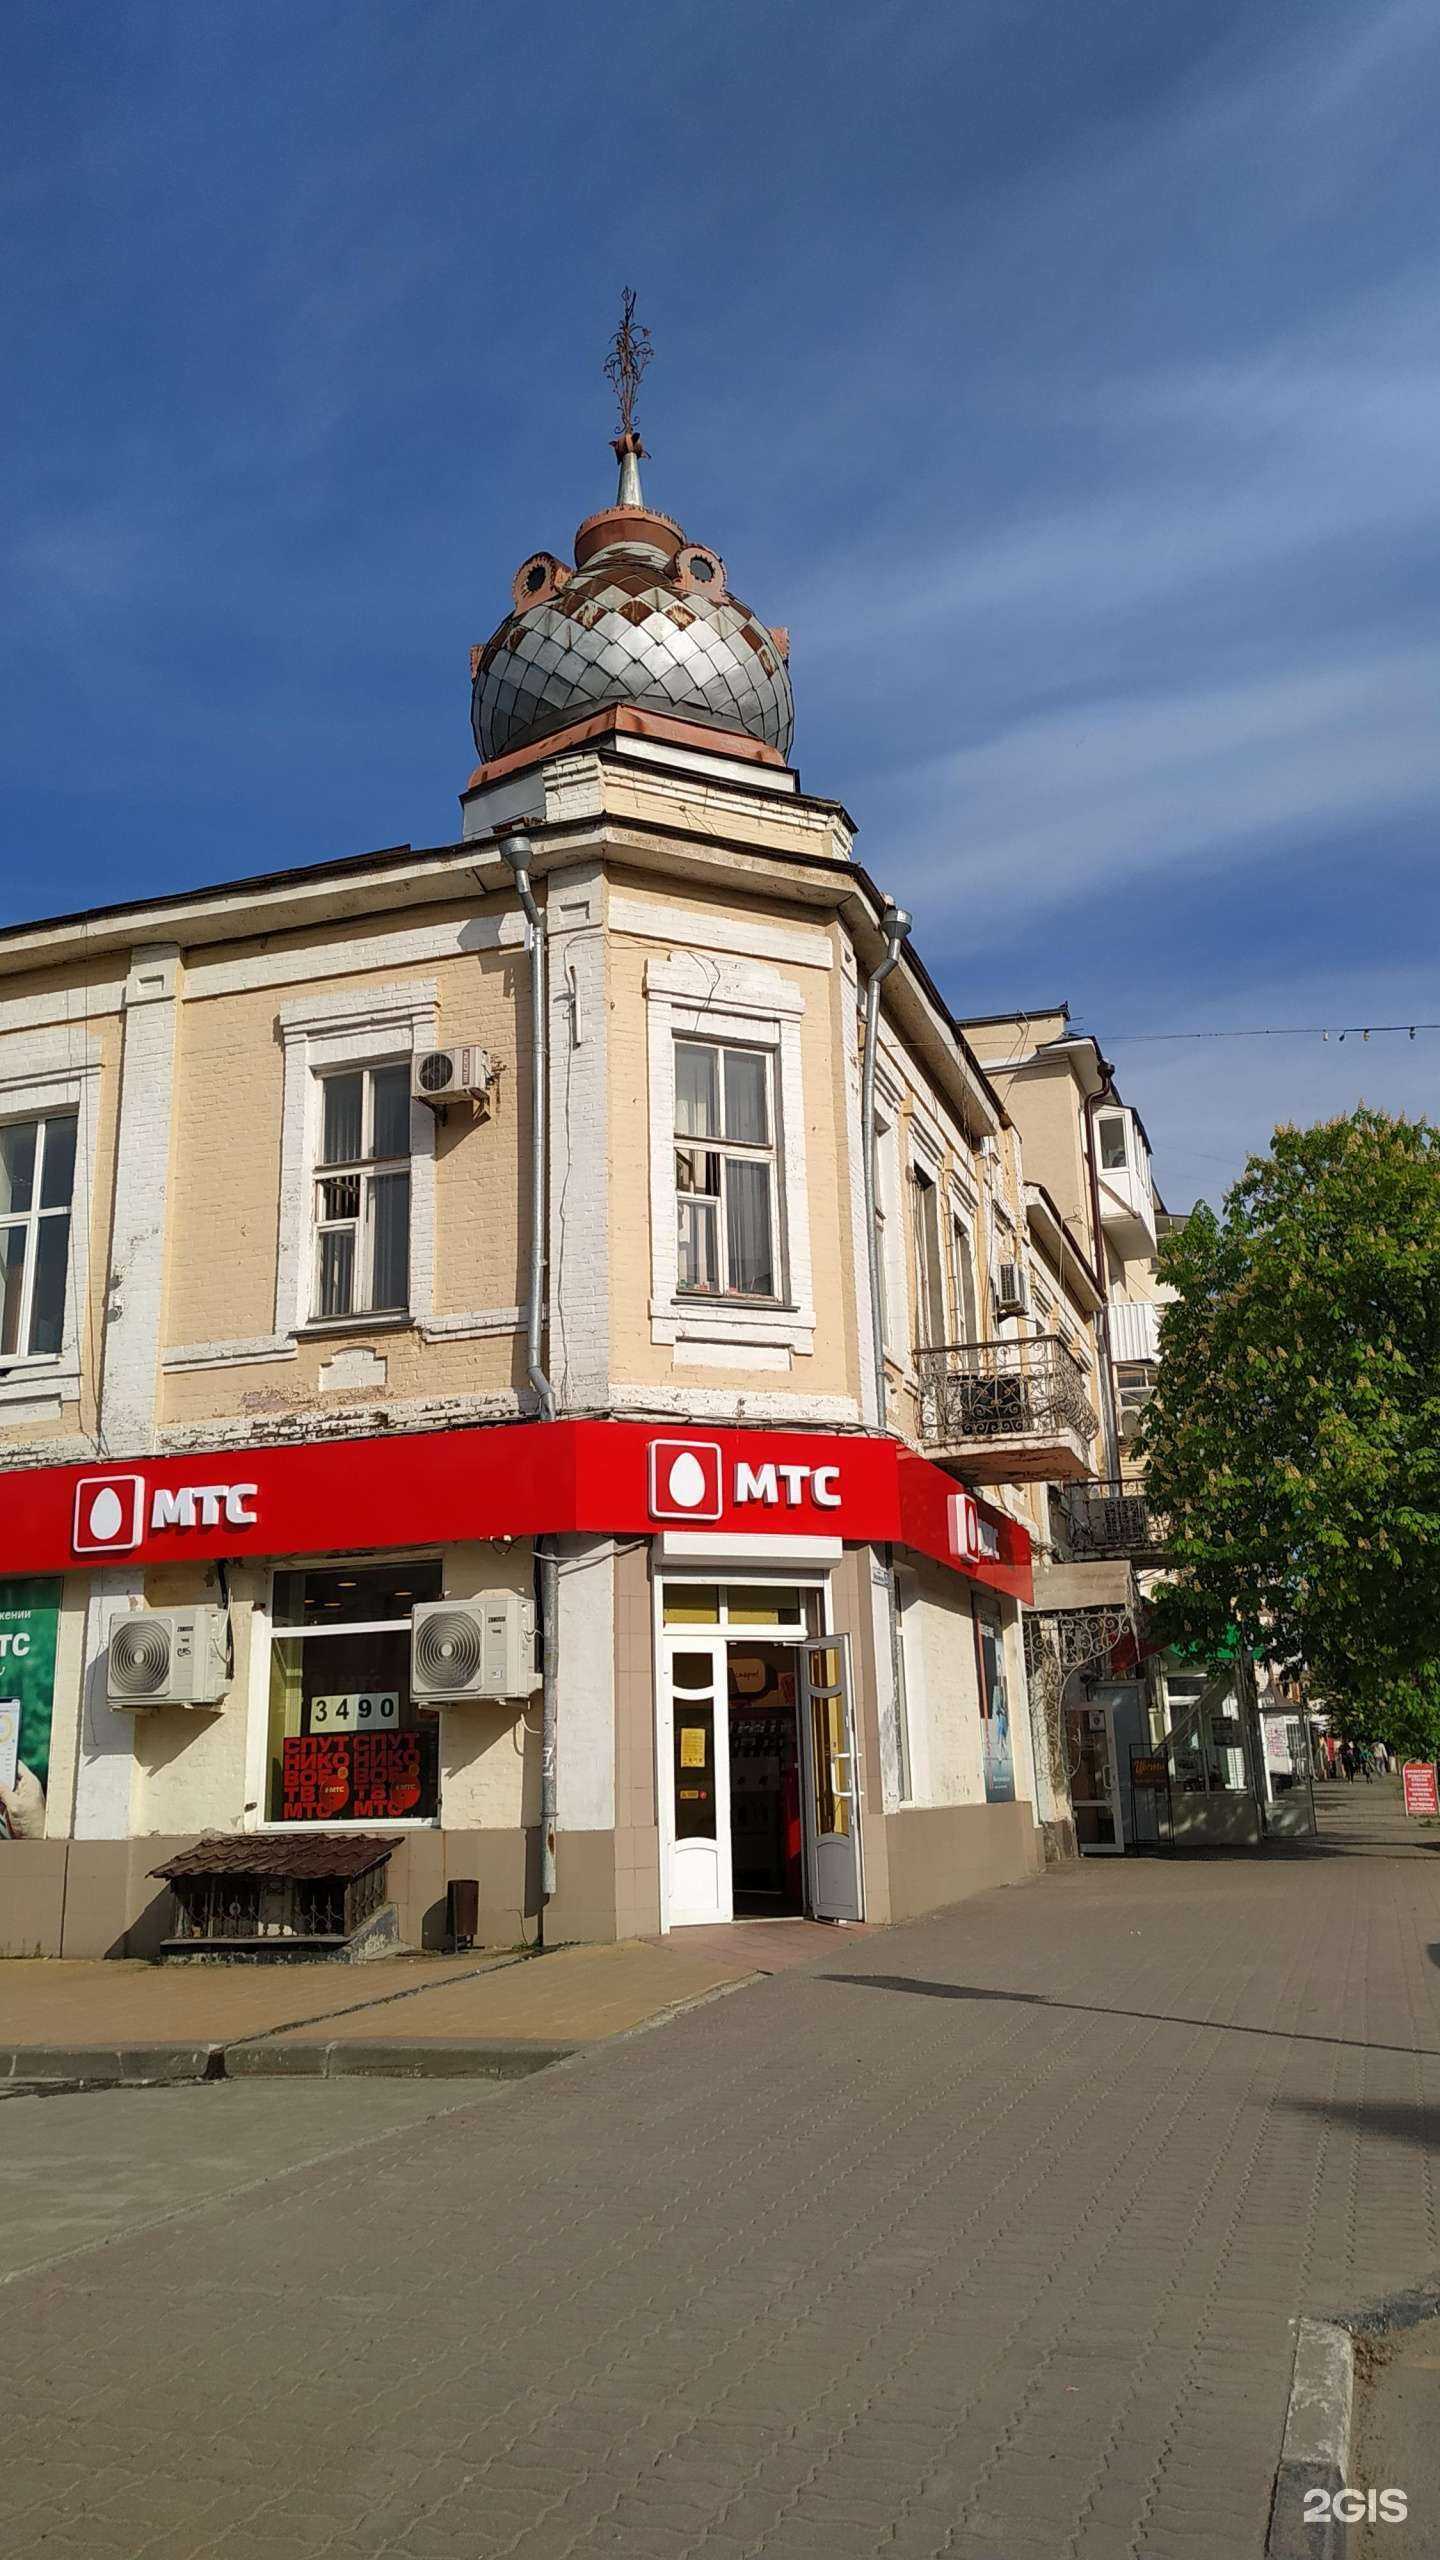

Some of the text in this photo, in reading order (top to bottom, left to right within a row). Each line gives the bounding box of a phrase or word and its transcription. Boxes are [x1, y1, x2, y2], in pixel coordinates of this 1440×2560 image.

[734, 1462, 842, 1507] МТС
[151, 1483, 258, 1528] МТС
[315, 1698, 394, 1721] 3490
[284, 1736, 350, 1754] СПУТ
[353, 1734, 417, 1751] СПУТ
[284, 1751, 350, 1769] НИКО
[354, 1749, 421, 1768] НИКО
[284, 1785, 316, 1802] ТВ
[354, 1783, 387, 1801] ТВ
[354, 1800, 403, 1817] МТС
